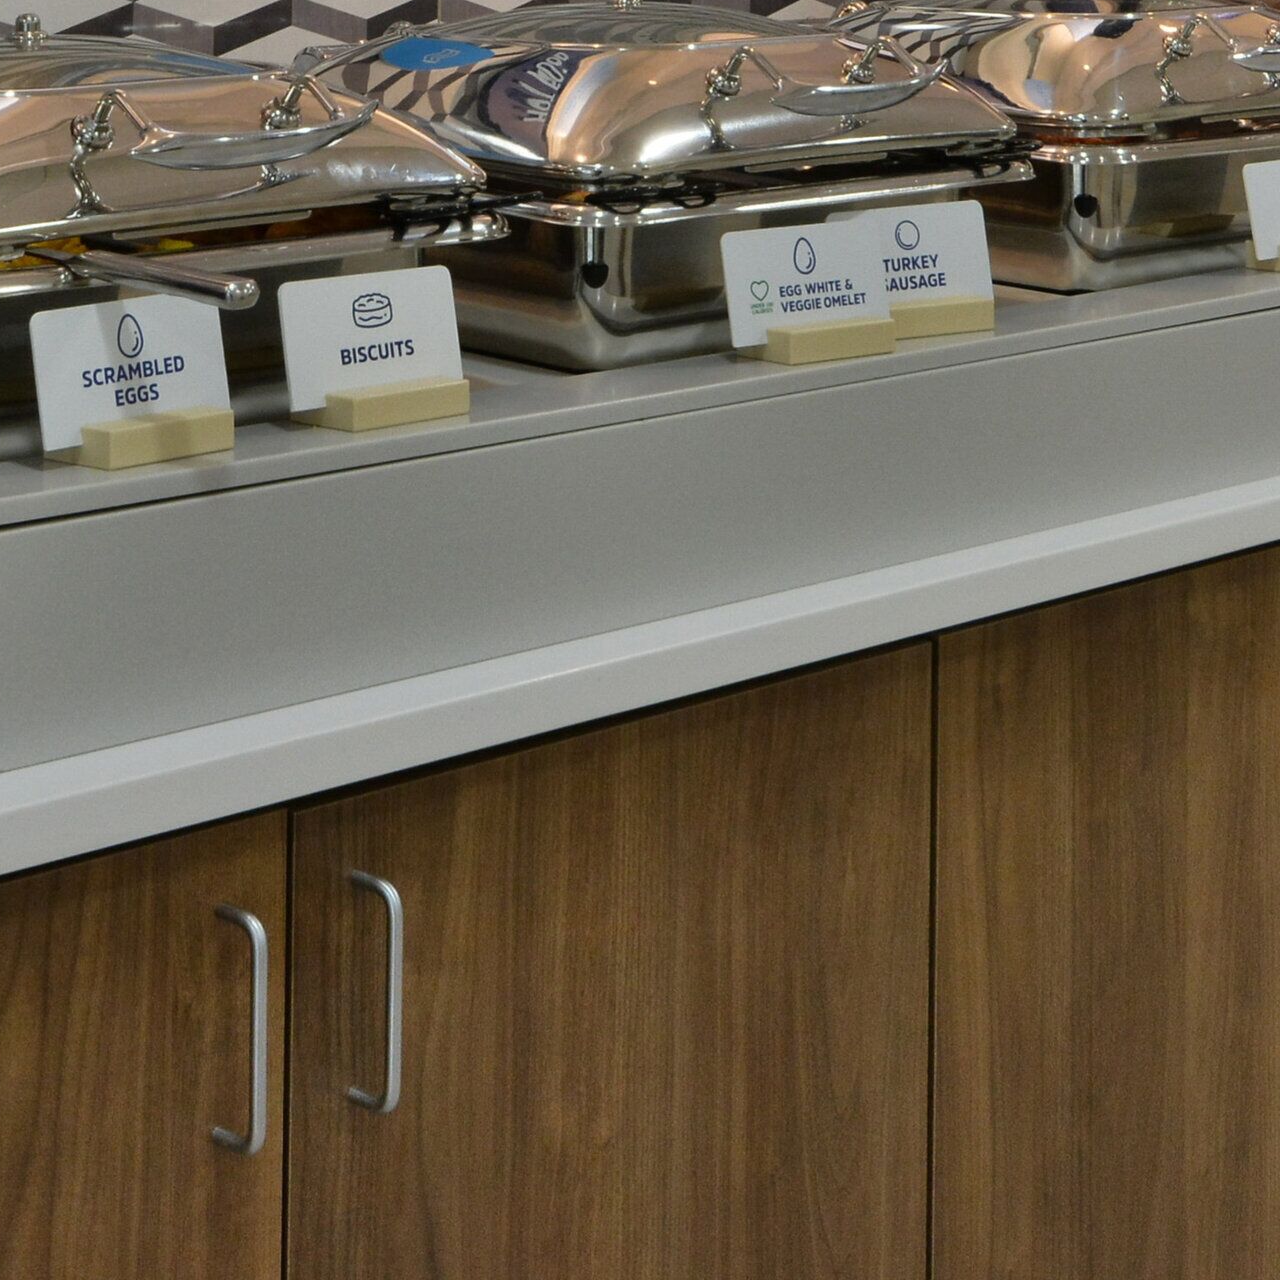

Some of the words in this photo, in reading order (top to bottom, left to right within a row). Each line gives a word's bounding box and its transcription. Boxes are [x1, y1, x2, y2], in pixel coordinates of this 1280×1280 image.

[883, 254, 938, 273] TURKEY
[779, 284, 802, 298] EGG
[804, 280, 842, 295] WHITE
[844, 278, 854, 291] &
[780, 297, 822, 313] VEGGIE
[823, 292, 867, 308] OMELET
[340, 338, 416, 366] BISCUITS
[81, 354, 186, 389] SCRAMBLED
[114, 382, 160, 408] EGGS
